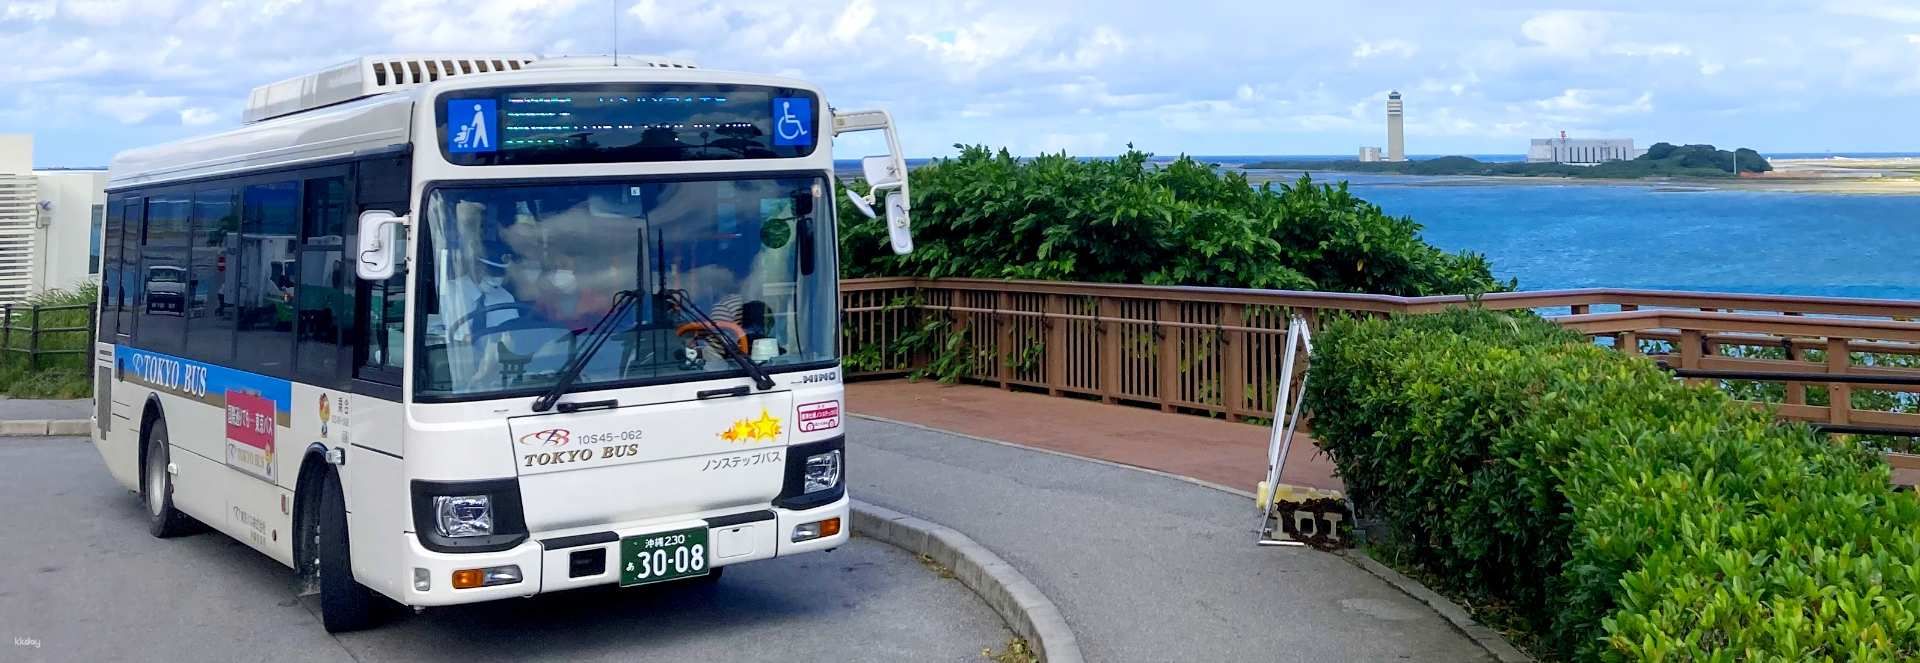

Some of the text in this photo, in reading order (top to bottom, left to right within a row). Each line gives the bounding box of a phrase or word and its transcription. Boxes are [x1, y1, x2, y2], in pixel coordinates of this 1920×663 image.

[143, 355, 207, 398] TOKYO BUS
[803, 372, 836, 384] HINO
[577, 430, 643, 445] 10S45-062
[524, 443, 638, 467] TOKYO BUS
[702, 451, 782, 471] ノンステップバス
[637, 543, 705, 579] 30-08
